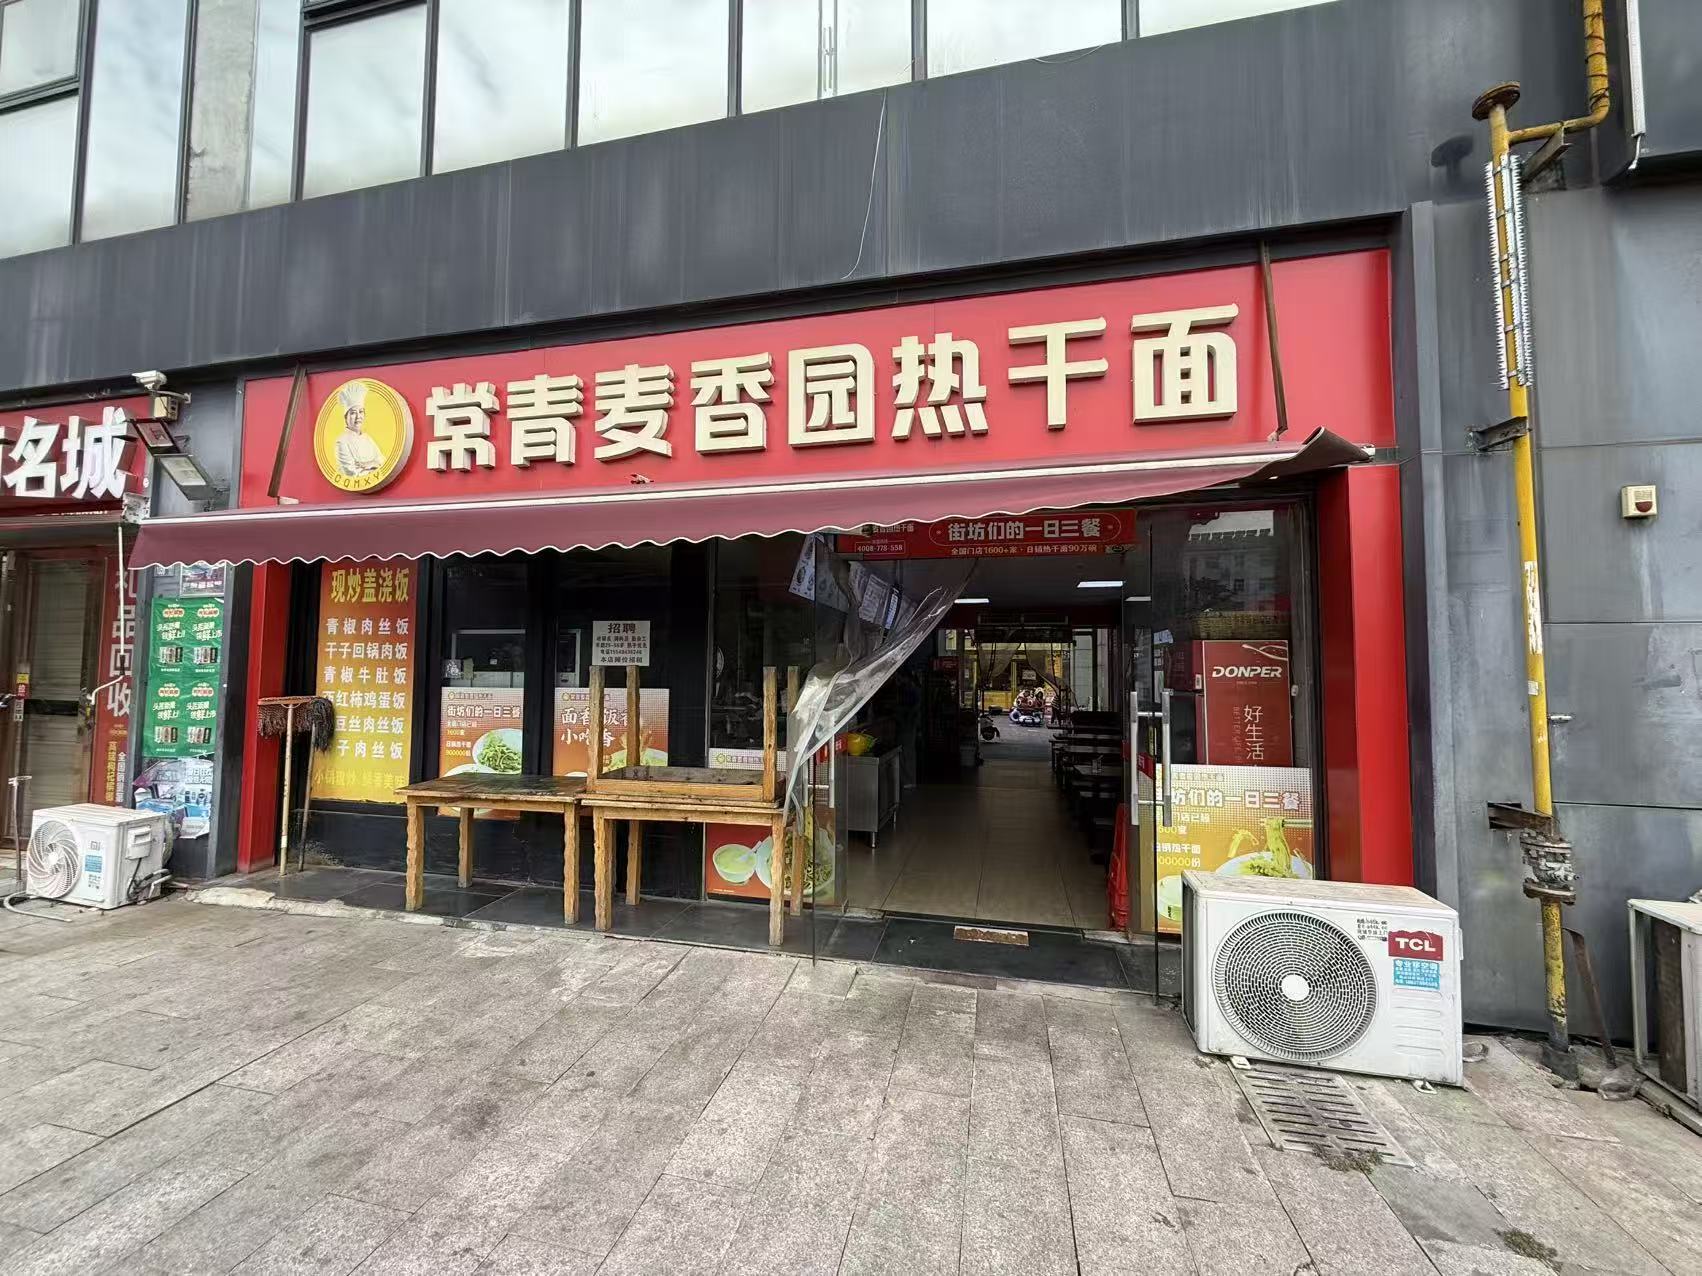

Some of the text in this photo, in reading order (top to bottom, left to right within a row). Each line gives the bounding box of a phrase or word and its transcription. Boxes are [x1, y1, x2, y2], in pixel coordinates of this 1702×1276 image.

[426, 303, 1238, 473] 常青麦香园热干面
[0, 406, 128, 499] 名城
[948, 518, 1101, 541] 街坊们的一日三餐
[330, 568, 409, 603] 现炒盖浇饭
[326, 617, 409, 636] 青椒肉丝饭
[607, 622, 636, 634] 招聘
[325, 642, 408, 660] 干子回锅肉饭
[323, 667, 407, 684] 青椒牛肚饭
[1212, 666, 1283, 678] DONPER
[447, 705, 521, 718] 街坊们的一日三餐
[334, 716, 405, 735] 豆丝肉丝饭
[1243, 704, 1265, 760] 好生活
[337, 739, 404, 760] 子肉丝饭
[1157, 788, 1301, 811] 坊们的一日三餐
[1395, 937, 1436, 952] TCL
